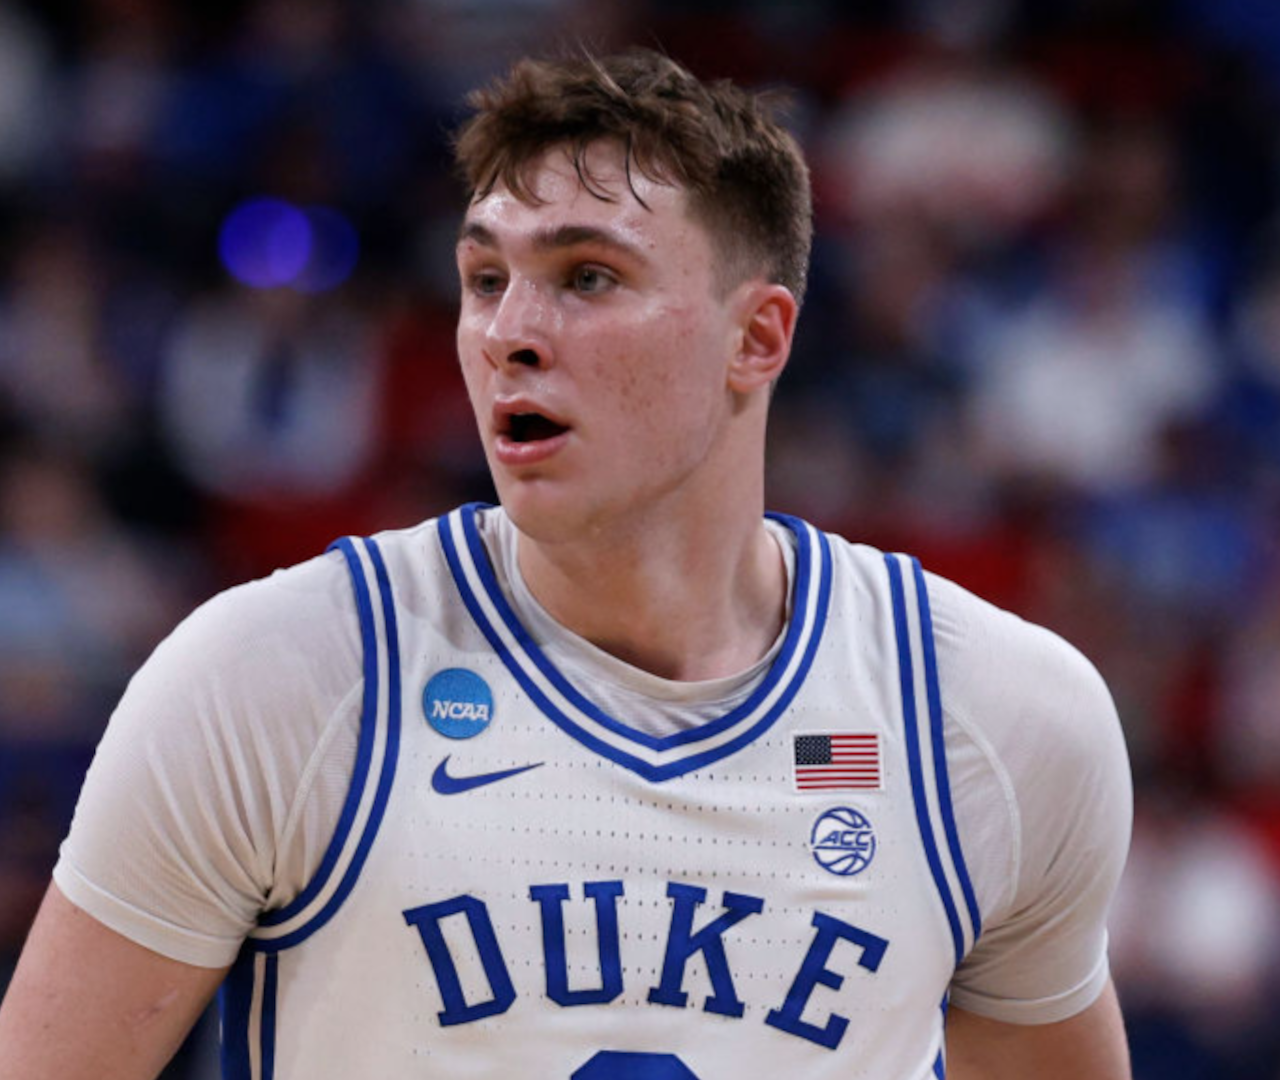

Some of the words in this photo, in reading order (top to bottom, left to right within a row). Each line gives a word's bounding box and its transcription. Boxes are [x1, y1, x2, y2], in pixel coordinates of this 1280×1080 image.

[431, 699, 489, 721] NCAA
[819, 830, 873, 846] ACC
[403, 880, 889, 1050] DUKE
